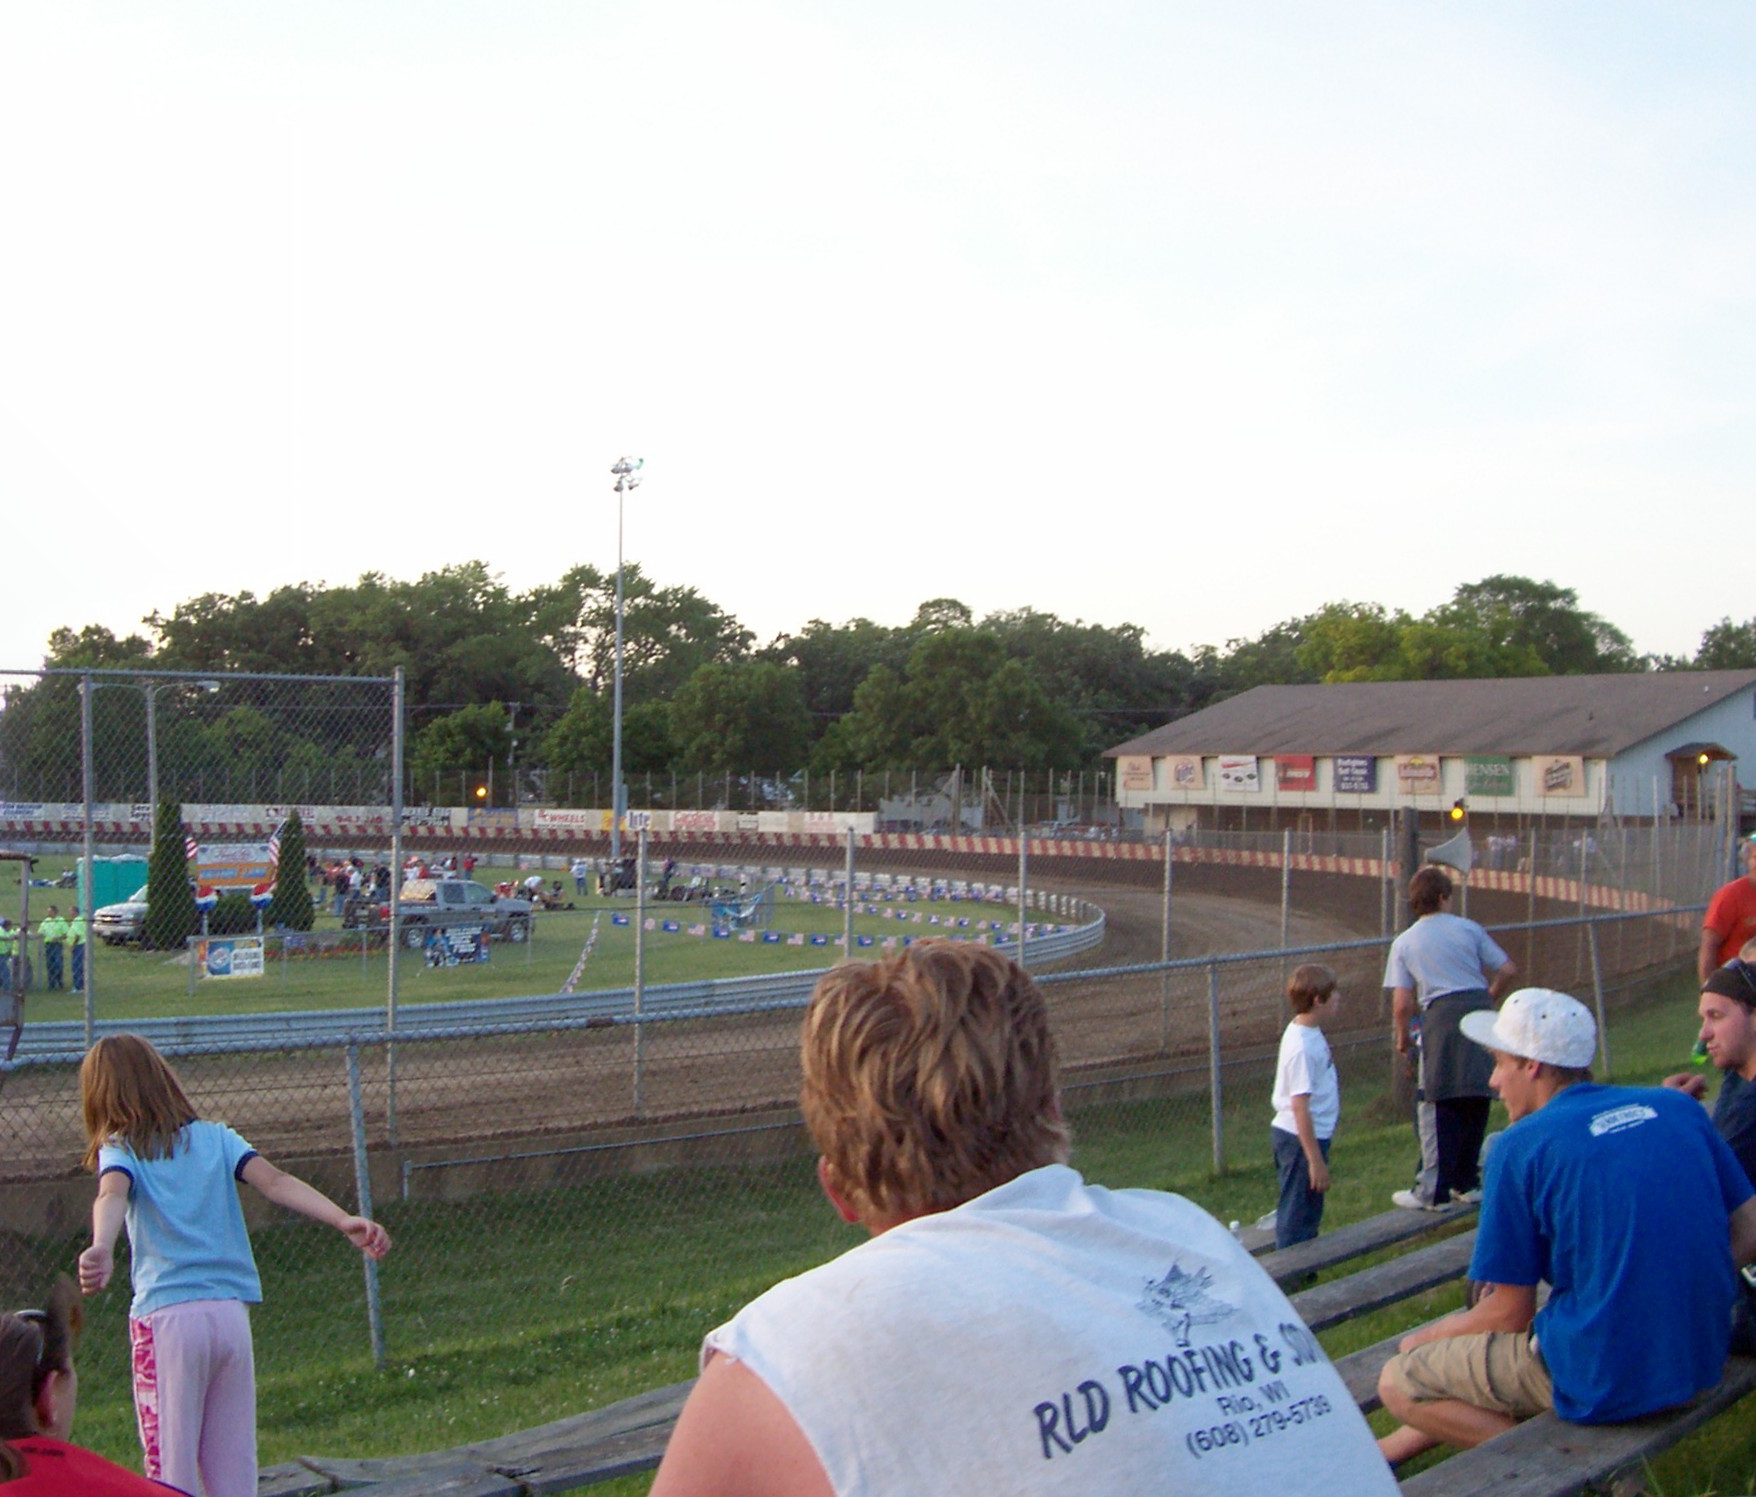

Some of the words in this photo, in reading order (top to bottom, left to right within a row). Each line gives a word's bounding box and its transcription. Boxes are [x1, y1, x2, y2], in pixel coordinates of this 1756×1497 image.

[1033, 1379, 1112, 1460] RLD
[1117, 1340, 1255, 1414] ROOFING
[1253, 1332, 1281, 1374] &
[1216, 1394, 1264, 1417] Rio,
[1259, 1379, 1291, 1404] WI
[1185, 1420, 1250, 1460] (608)
